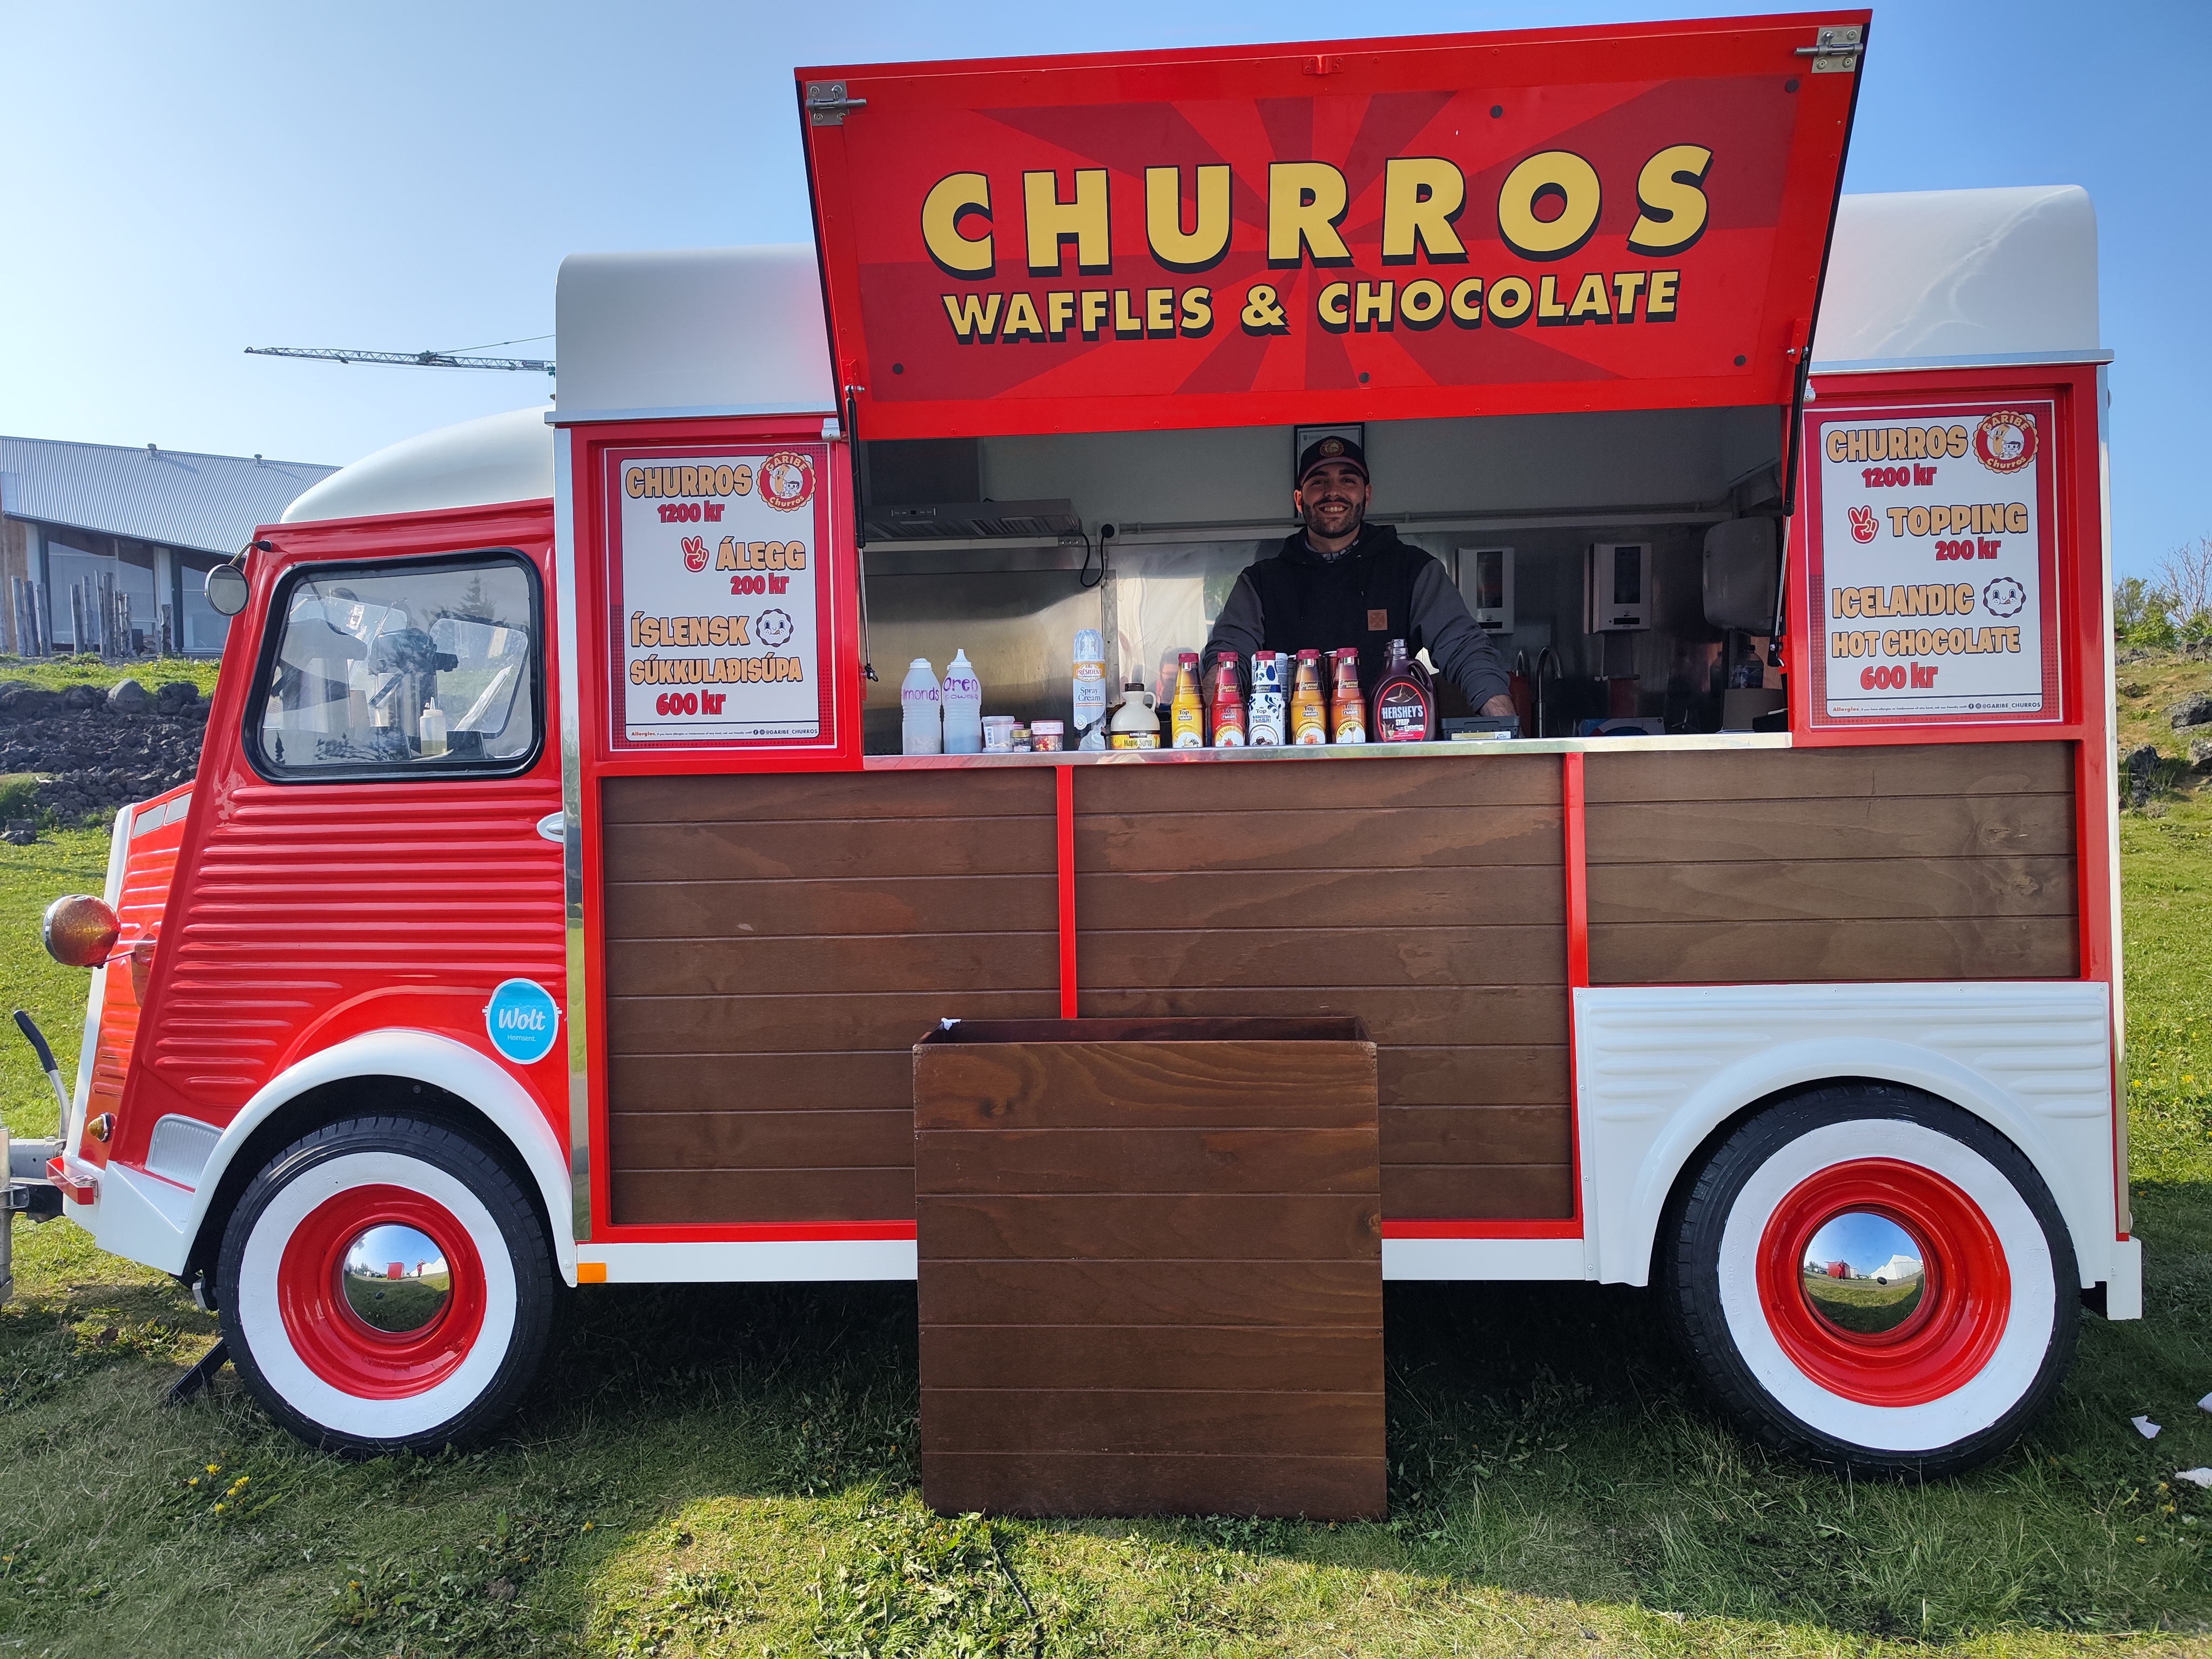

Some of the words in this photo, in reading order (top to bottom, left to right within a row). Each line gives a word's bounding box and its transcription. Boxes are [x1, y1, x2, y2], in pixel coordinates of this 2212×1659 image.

[921, 143, 1715, 278] CHURROS
[942, 286, 1213, 345] WAFFLES
[1240, 284, 1291, 336] &
[1316, 268, 1681, 335] CHOCOLATE
[1983, 414, 2029, 433] GARIBE
[1826, 426, 1968, 463] CHURROS
[765, 453, 807, 472] GARIBE
[1986, 455, 2026, 469] Churros
[626, 466, 752, 498] CHURROS
[1862, 467, 1911, 488] 1200
[1913, 463, 1937, 486] kr
[658, 504, 701, 523] 1200
[704, 501, 725, 522] kr
[769, 495, 805, 508] Churros
[1886, 503, 2028, 536] TOPPING
[716, 536, 806, 571] ÁLEGG
[1935, 541, 1974, 561] 200
[1977, 537, 2001, 560] kr
[731, 575, 766, 595] 200
[769, 572, 790, 594] kr
[1832, 583, 1974, 619] ICELANDIC
[631, 611, 750, 648] ÍSLENSK
[1831, 630, 1880, 658] HOT
[1883, 626, 2021, 657] CHOCOLATE
[630, 652, 804, 685] SÚKKULAÐISÚPA
[1860, 666, 1907, 690] 600
[1910, 662, 1938, 689] kr
[901, 687, 939, 701] lmonds
[943, 677, 978, 692] Oreo
[1080, 687, 1098, 696] Spray
[656, 693, 698, 716] 600
[702, 690, 726, 714] kr
[1382, 705, 1423, 719] HERSHEY'S
[498, 1008, 546, 1031] Wolt
